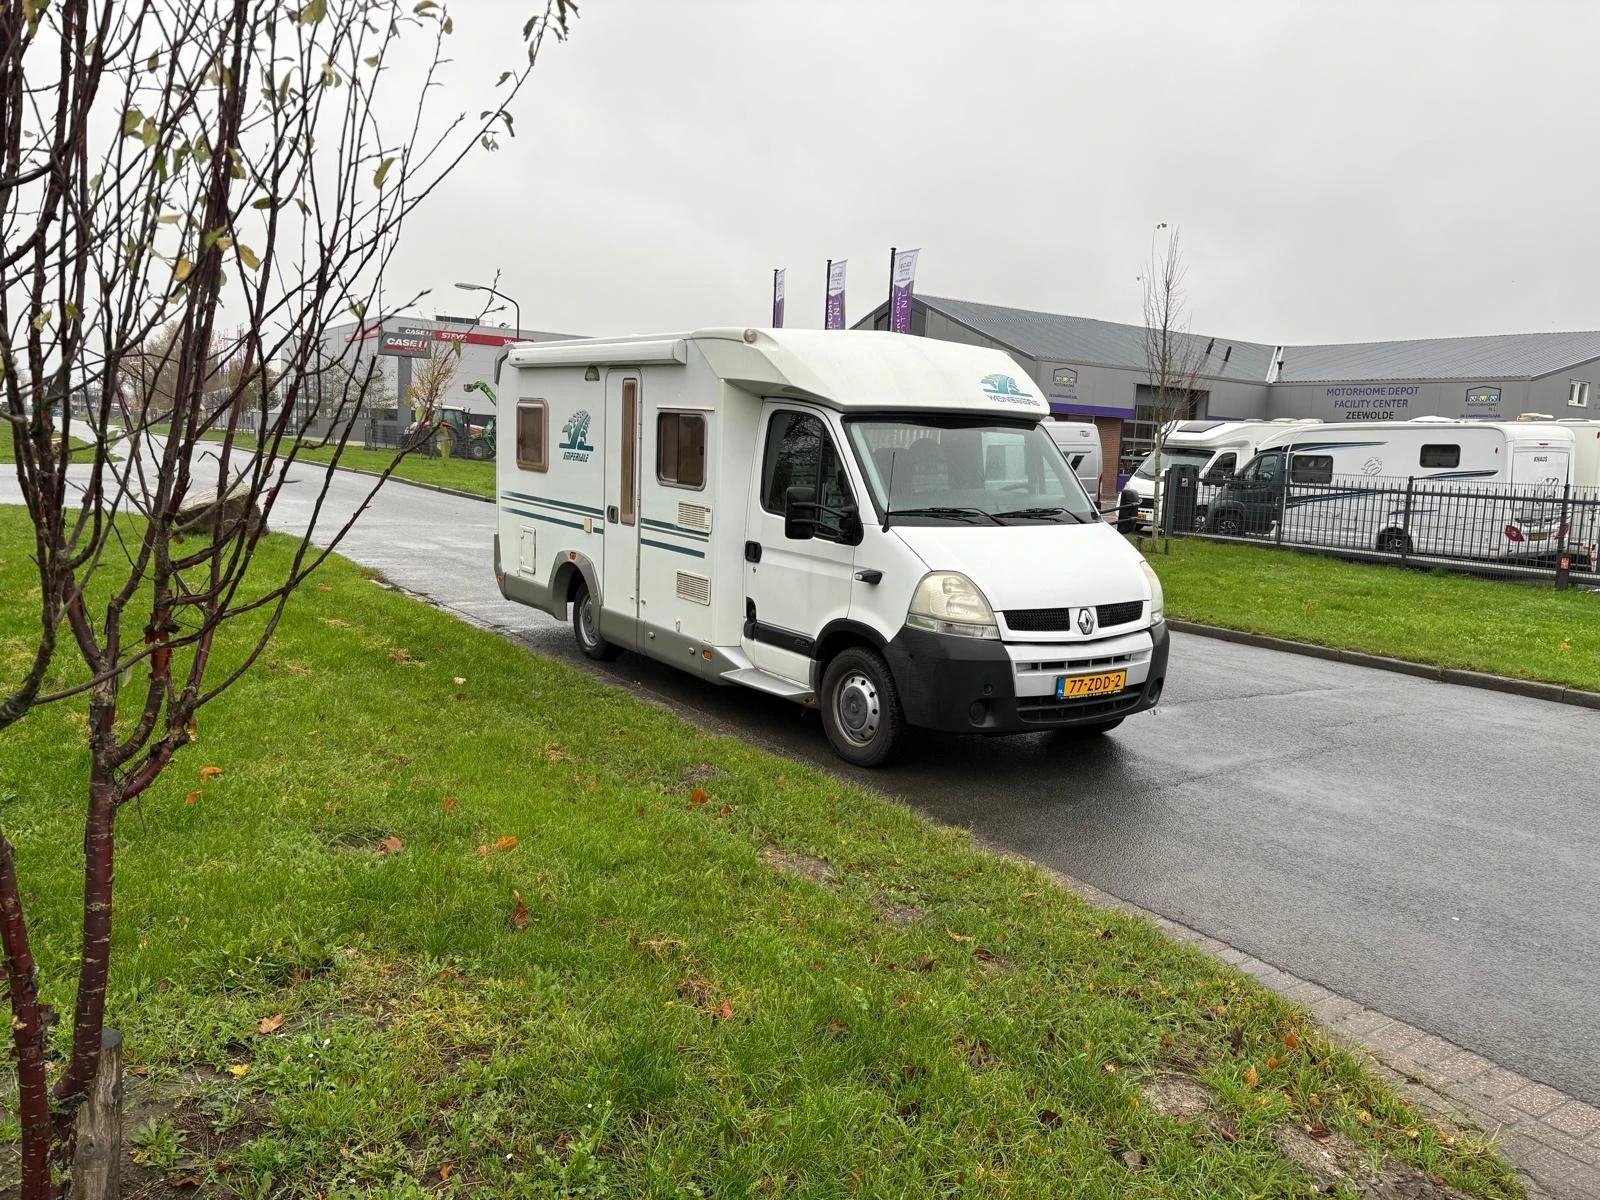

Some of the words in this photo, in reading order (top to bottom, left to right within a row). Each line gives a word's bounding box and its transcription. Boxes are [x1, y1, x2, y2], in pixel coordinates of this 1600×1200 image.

[405, 328, 425, 336] CASE
[386, 337, 418, 347] CASE
[1327, 387, 1387, 397] MOTORHOME
[1388, 386, 1420, 396] DEPOT
[1334, 399, 1371, 409] FACILITY
[1373, 399, 1409, 408] CENTER
[1345, 411, 1395, 420] ZEEWOLDE
[1069, 674, 1121, 694] 77-ZDD-2
